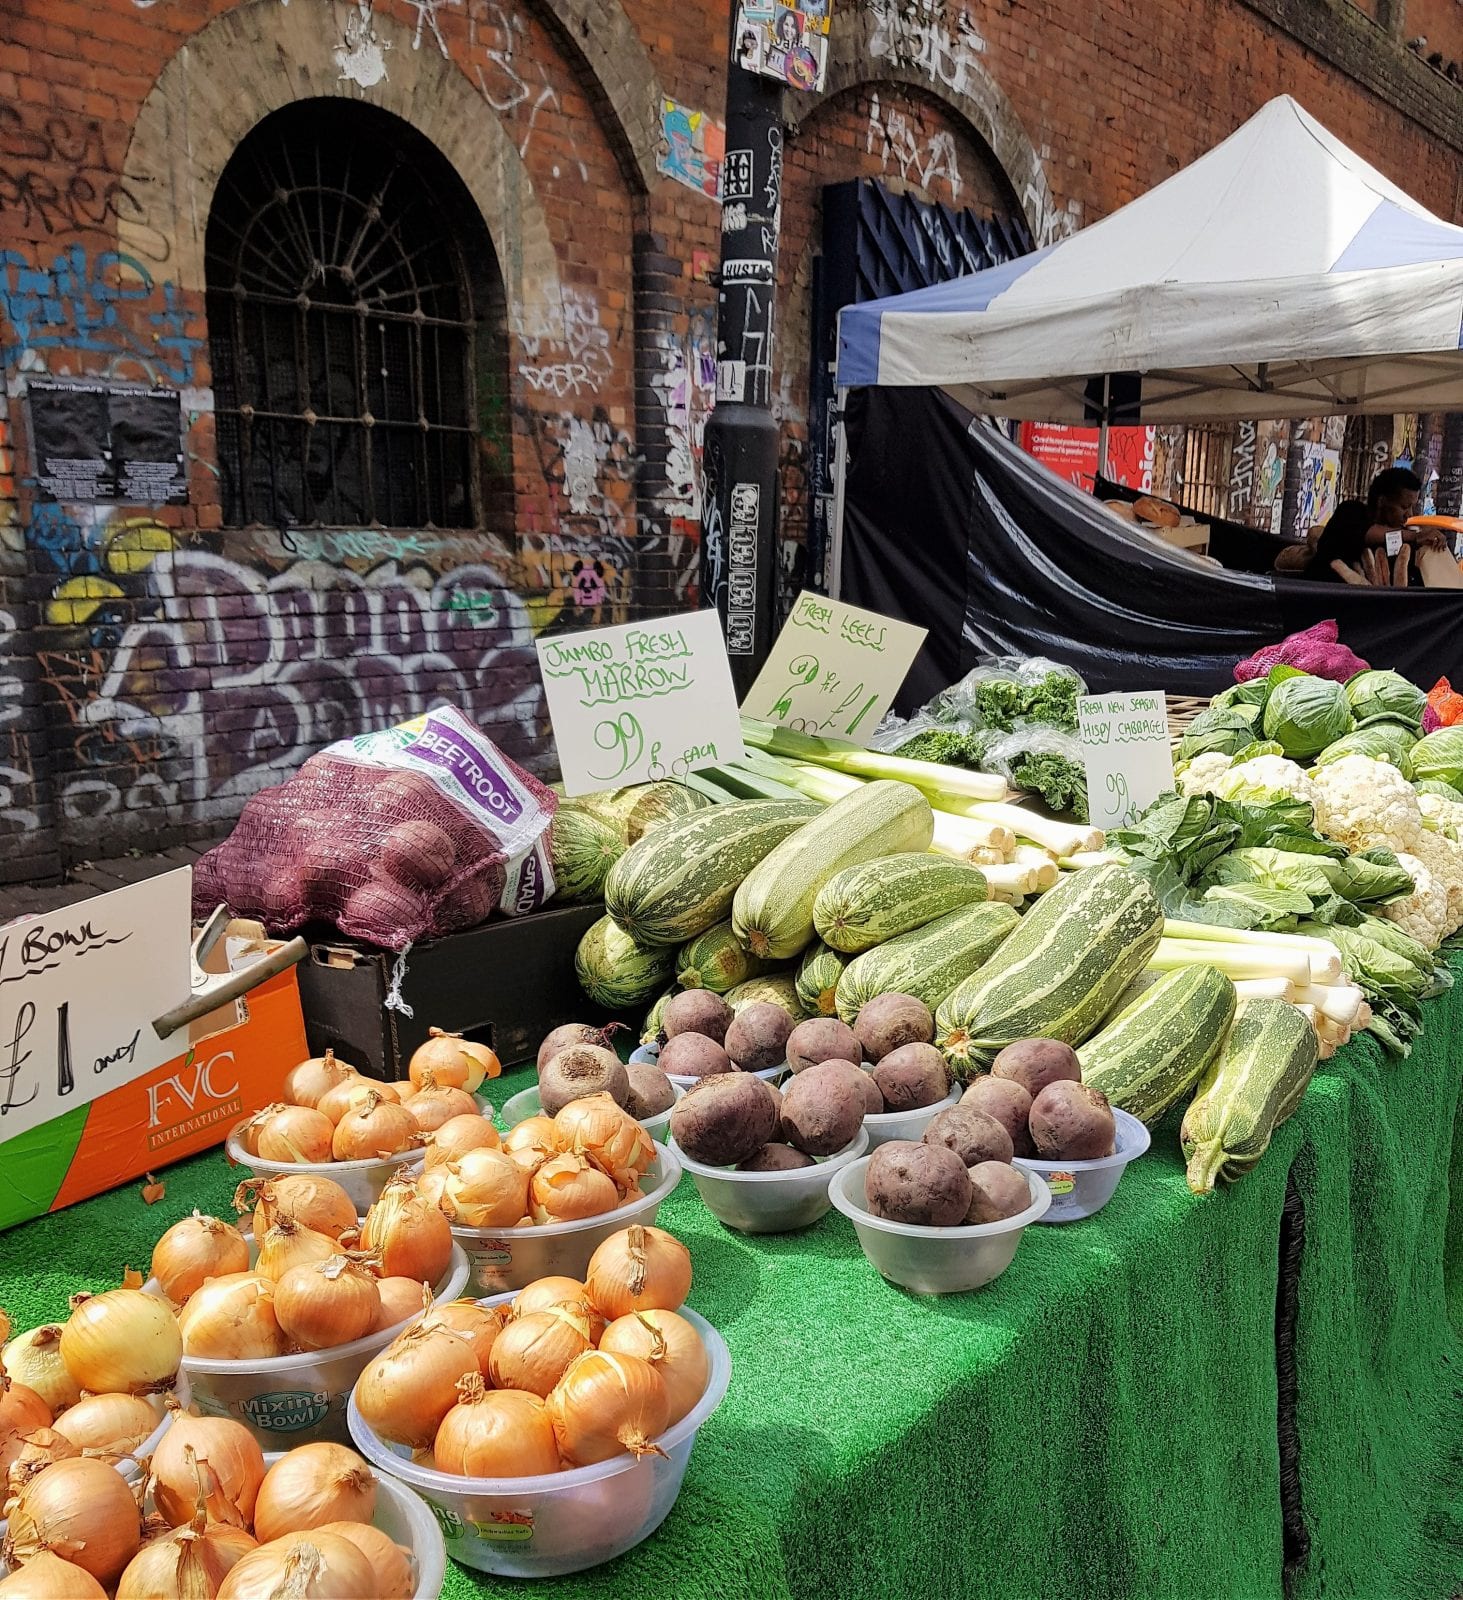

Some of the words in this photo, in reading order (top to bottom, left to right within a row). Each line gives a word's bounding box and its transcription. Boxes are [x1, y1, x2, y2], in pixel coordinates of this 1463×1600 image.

[797, 597, 833, 625] FRESH
[543, 640, 613, 667] JUMBO
[625, 630, 689, 659] FRESH
[573, 662, 687, 697] MARROW
[1079, 699, 1104, 717] FRESH
[1107, 700, 1125, 714] NEW
[1129, 698, 1159, 712] SEASON
[1083, 721, 1111, 742] HISPY
[683, 742, 718, 764] EACH
[417, 730, 516, 817] BEETROOT
[145, 1050, 240, 1129] FVC
[151, 1101, 240, 1146] INTERNATIONAL
[238, 1390, 329, 1414] Mixing
[255, 1407, 314, 1428] Bowl
